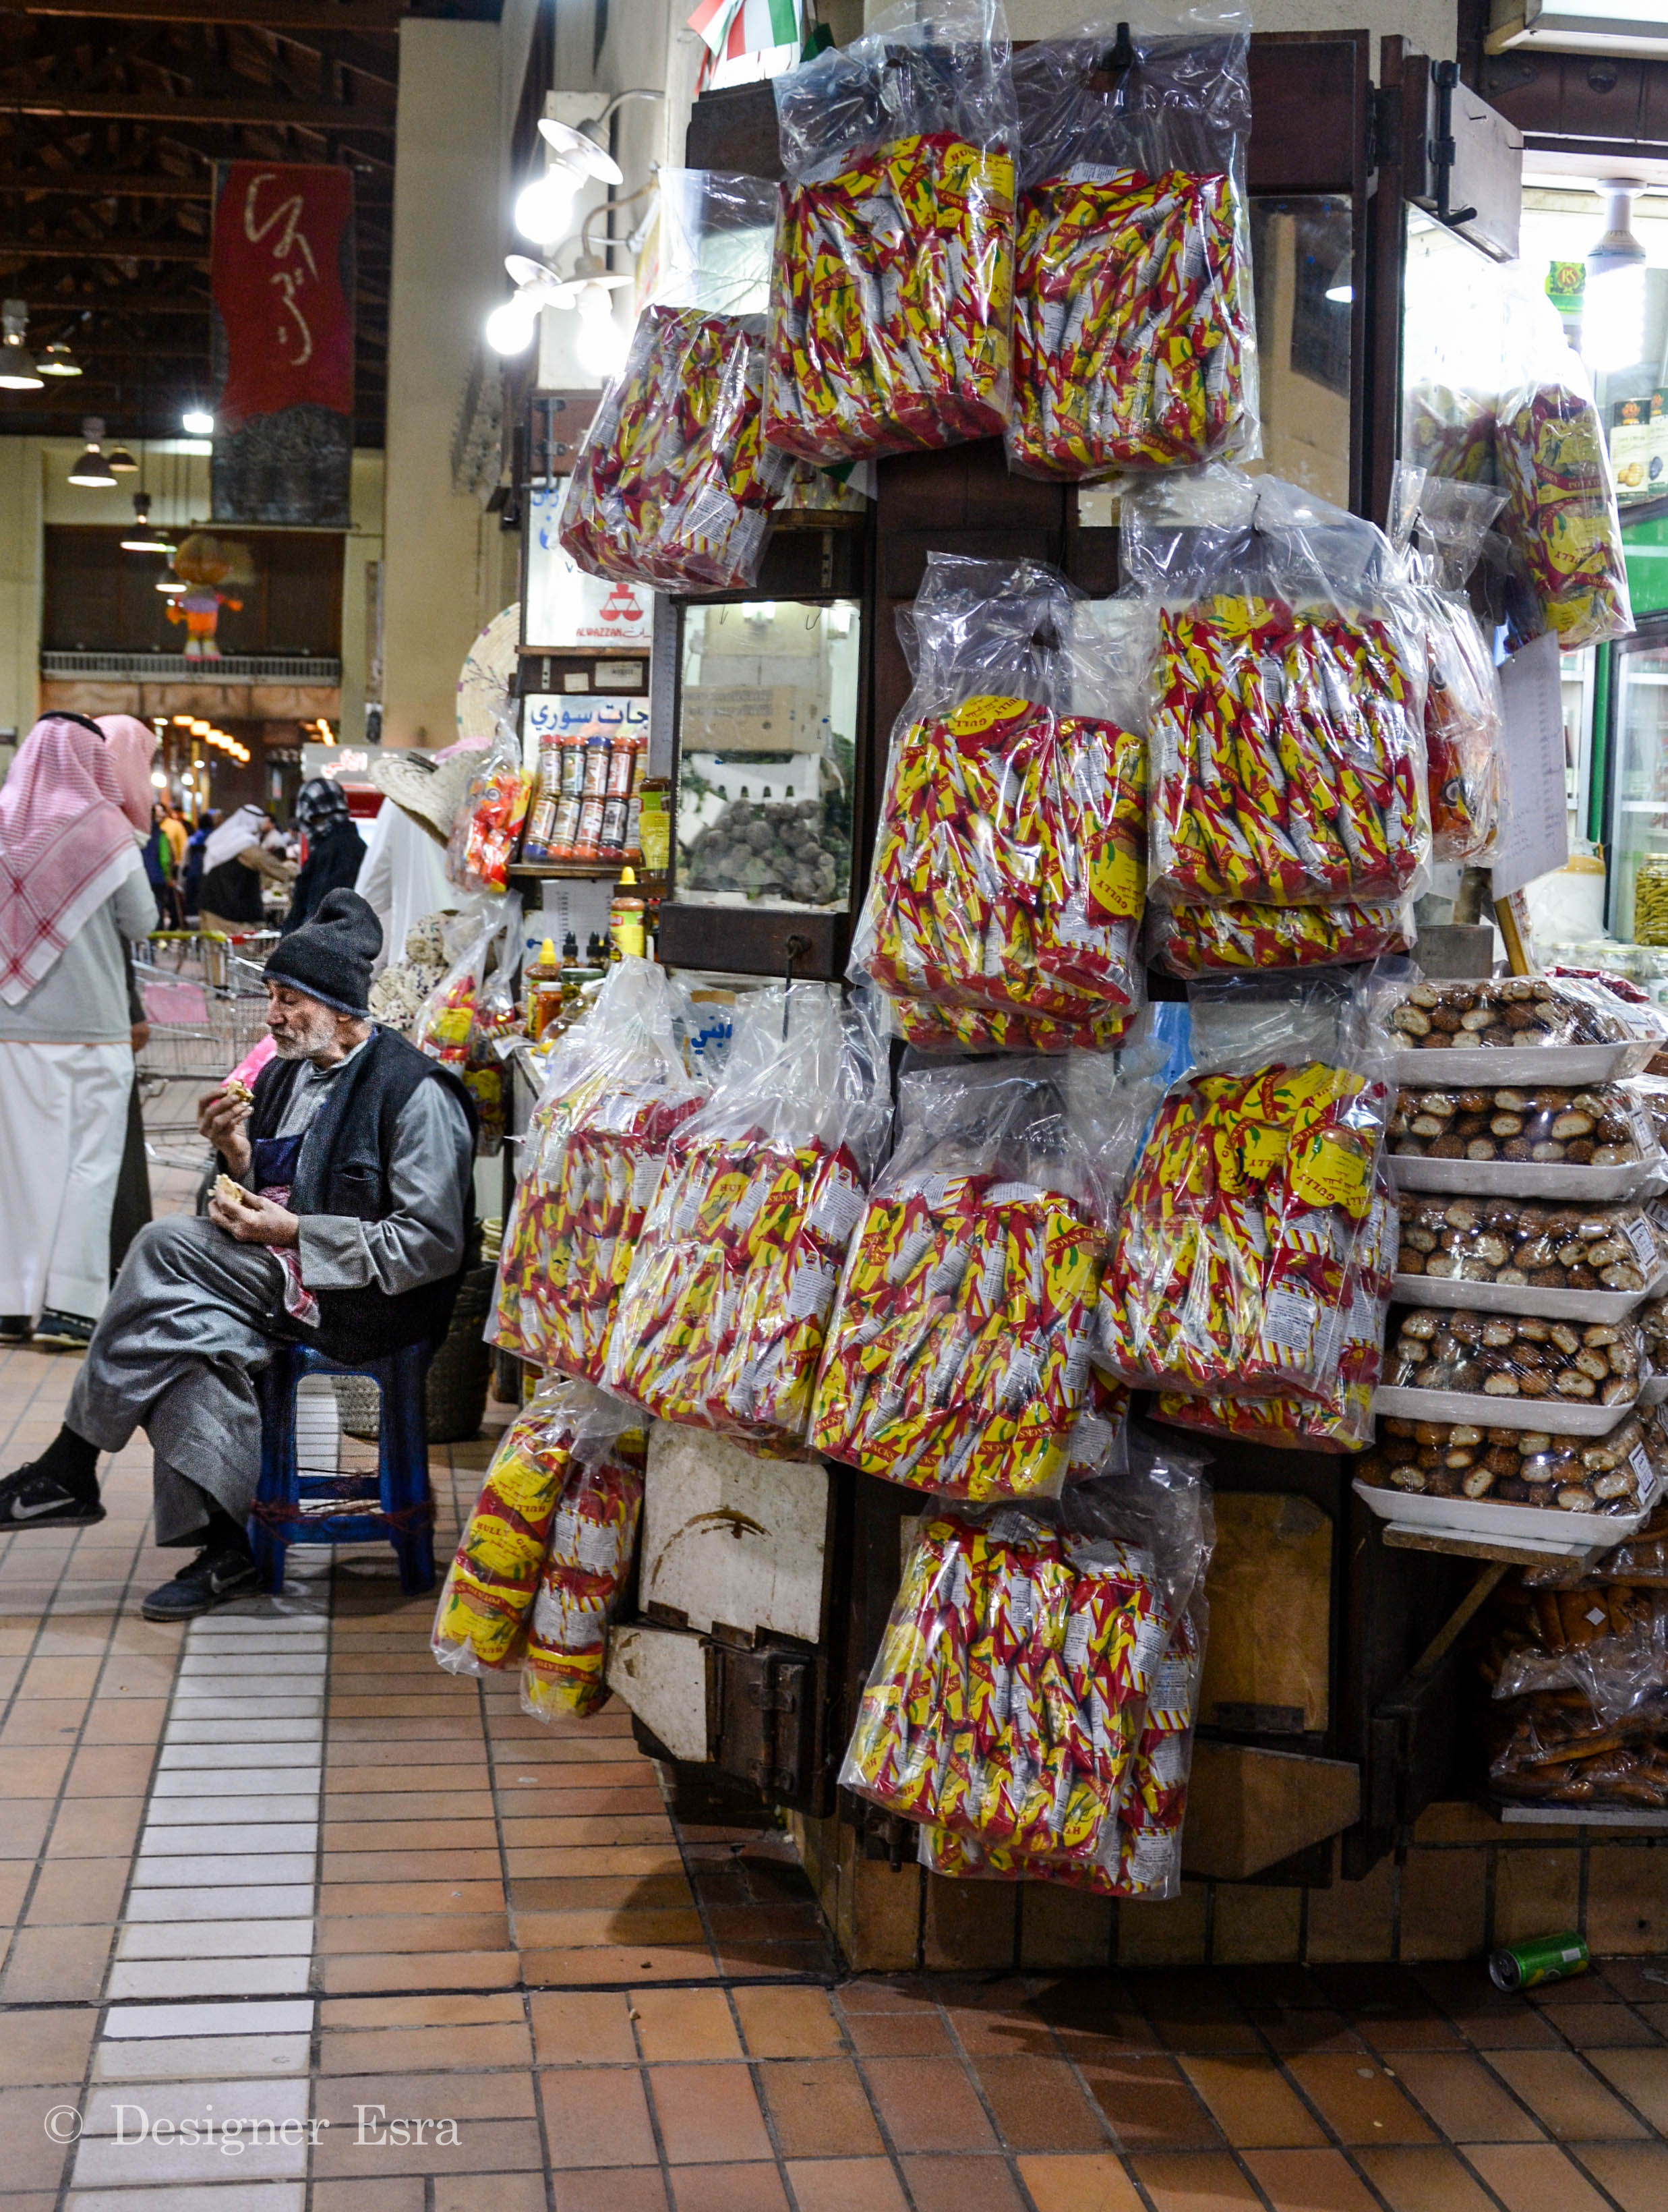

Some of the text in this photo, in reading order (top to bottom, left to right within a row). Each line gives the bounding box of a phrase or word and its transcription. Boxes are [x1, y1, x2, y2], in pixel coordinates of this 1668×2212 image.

[577, 628, 622, 637] ALWAZZAN
[531, 705, 592, 730] سوري
[957, 718, 986, 726] GULL
[1096, 879, 1128, 909] GULLY
[1297, 1174, 1336, 1200] GULLY
[1046, 1231, 1080, 1252] SNACKS
